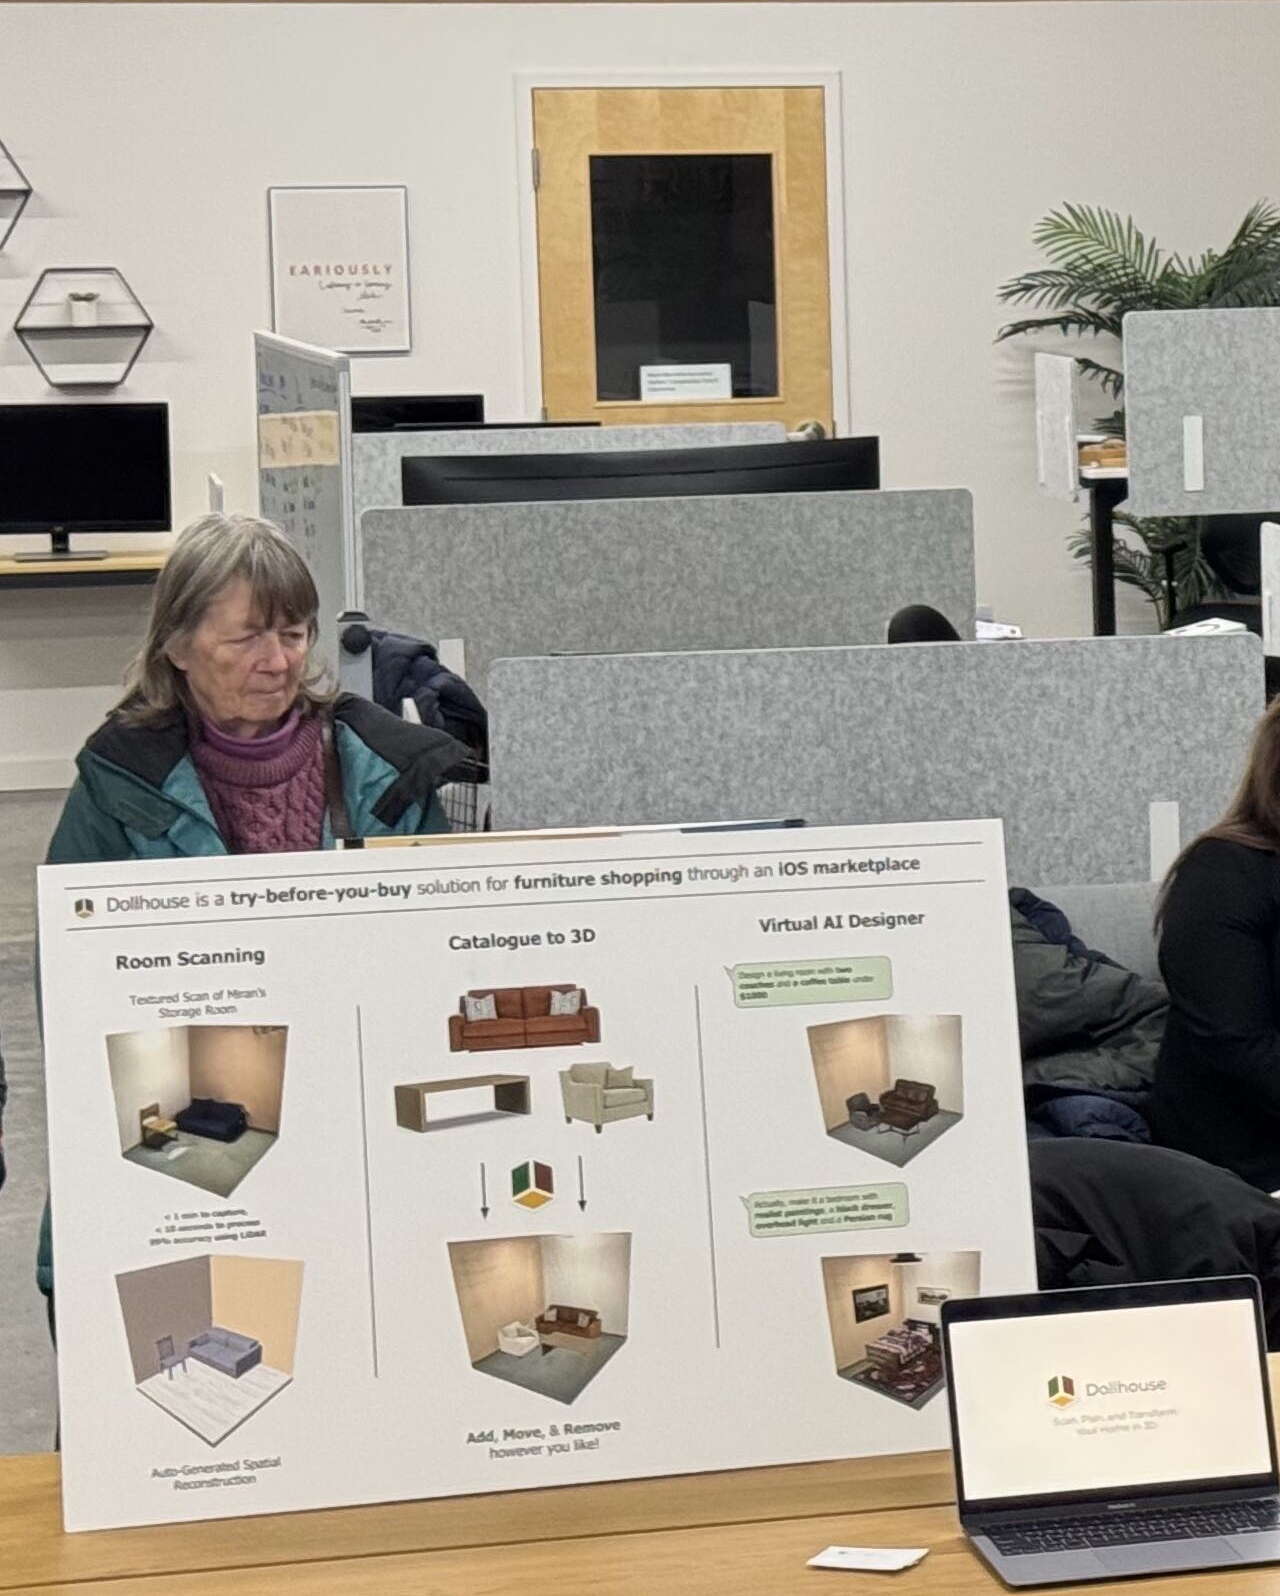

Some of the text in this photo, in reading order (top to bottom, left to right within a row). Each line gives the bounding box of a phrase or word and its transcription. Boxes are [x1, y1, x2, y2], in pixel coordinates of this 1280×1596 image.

[107, 895, 190, 913] Dollhouse
[196, 891, 210, 907] is
[214, 894, 225, 907] a
[230, 882, 412, 908] try-before-you-buy
[417, 879, 480, 896] solution
[486, 875, 508, 892] for
[514, 872, 596, 890] furniture
[600, 869, 682, 888] shopping
[687, 863, 749, 883] through
[754, 865, 773, 878] an
[813, 856, 920, 874] marketplace
[759, 911, 925, 933] Virtual AI Designer
[449, 928, 596, 951] Catalogue to 3D
[116, 947, 266, 970] Room Scanning
[182, 991, 210, 1003] Scan
[212, 989, 224, 1001] of
[158, 1004, 238, 1019] Storage Room
[1085, 1379, 1168, 1397] Dollhouse
[466, 1420, 622, 1445] Add, Move, & Remove
[489, 1445, 545, 1460] however
[545, 1442, 571, 1457] you
[173, 1475, 257, 1490] Reconstruction
